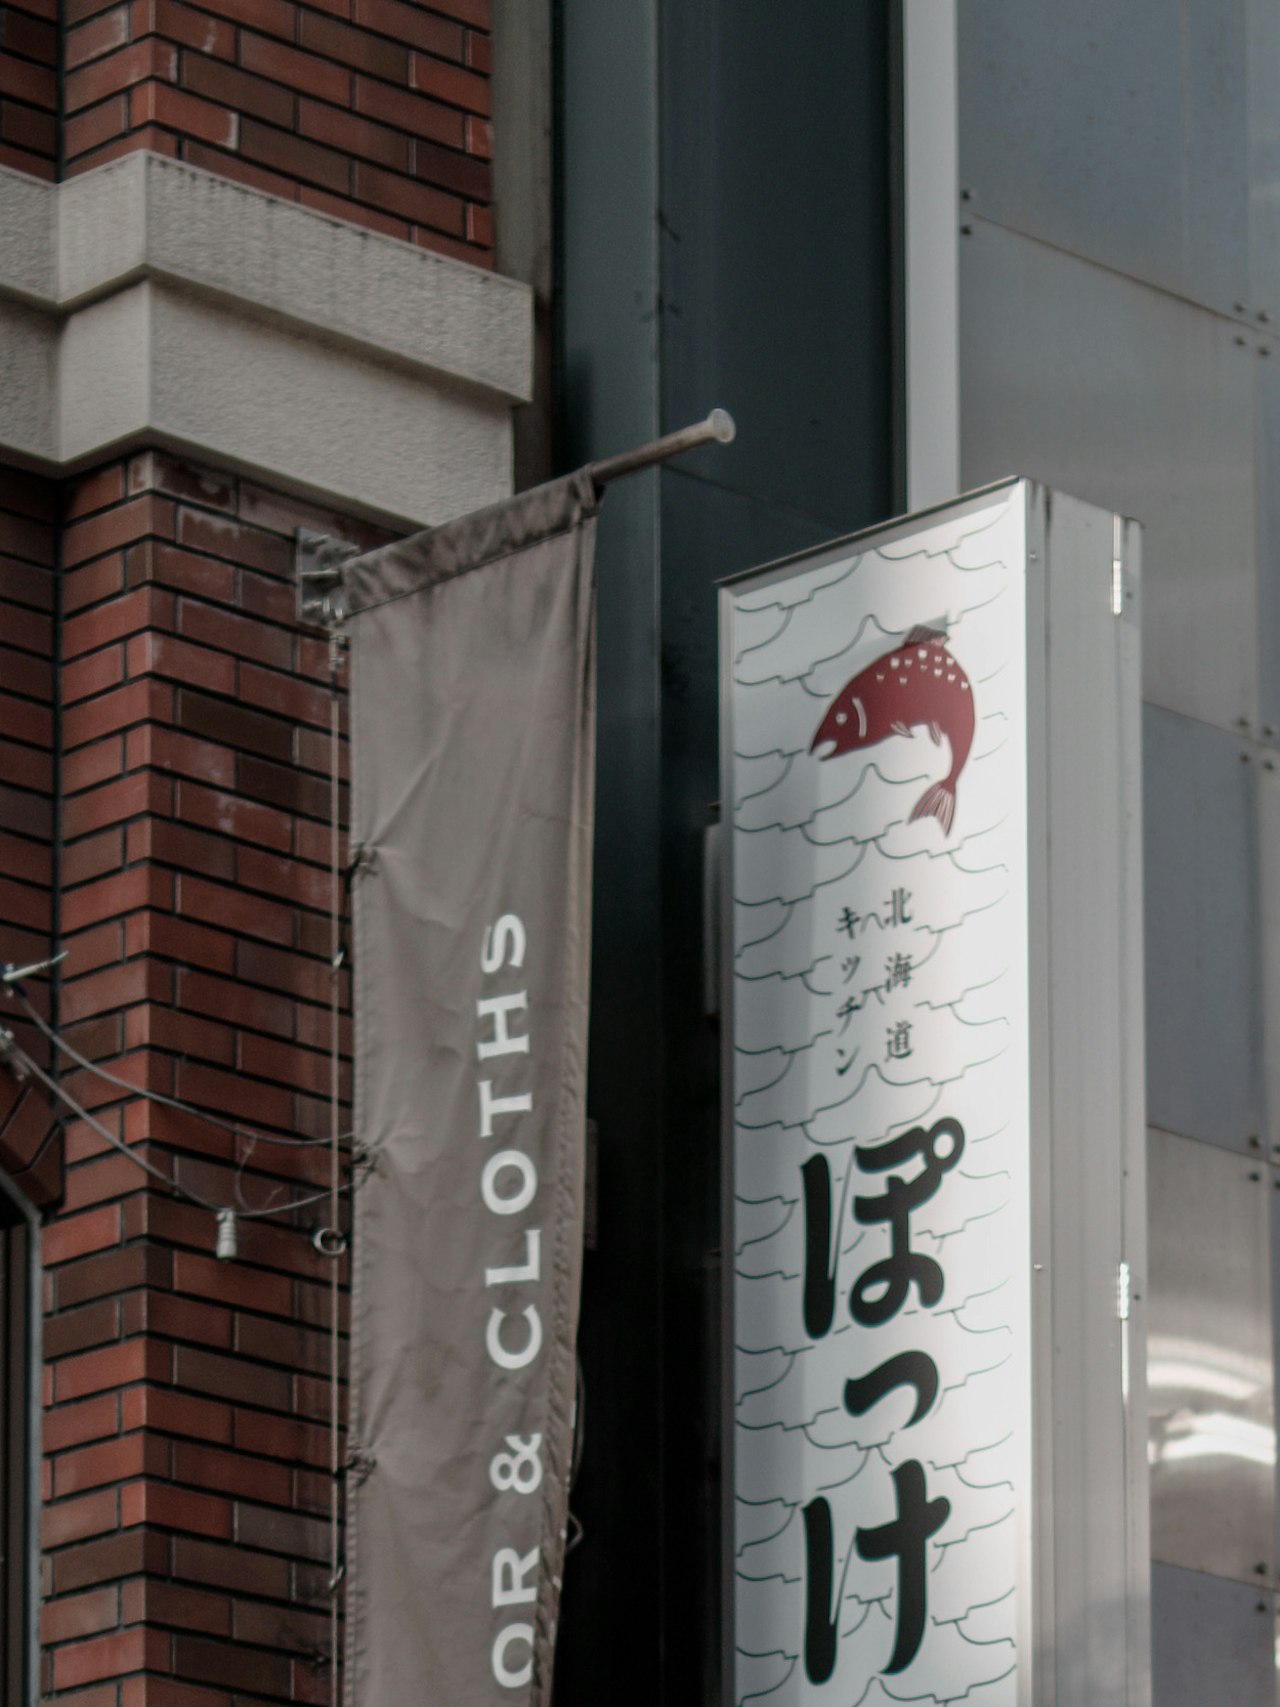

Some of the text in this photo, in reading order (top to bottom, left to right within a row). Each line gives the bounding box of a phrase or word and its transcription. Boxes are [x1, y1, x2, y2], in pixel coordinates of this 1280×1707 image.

[883, 886, 913, 1063] 北海道
[476, 911, 543, 1370] CLOTHS
[489, 1431, 543, 1495] &
[799, 1114, 966, 1687] ぽっけ
